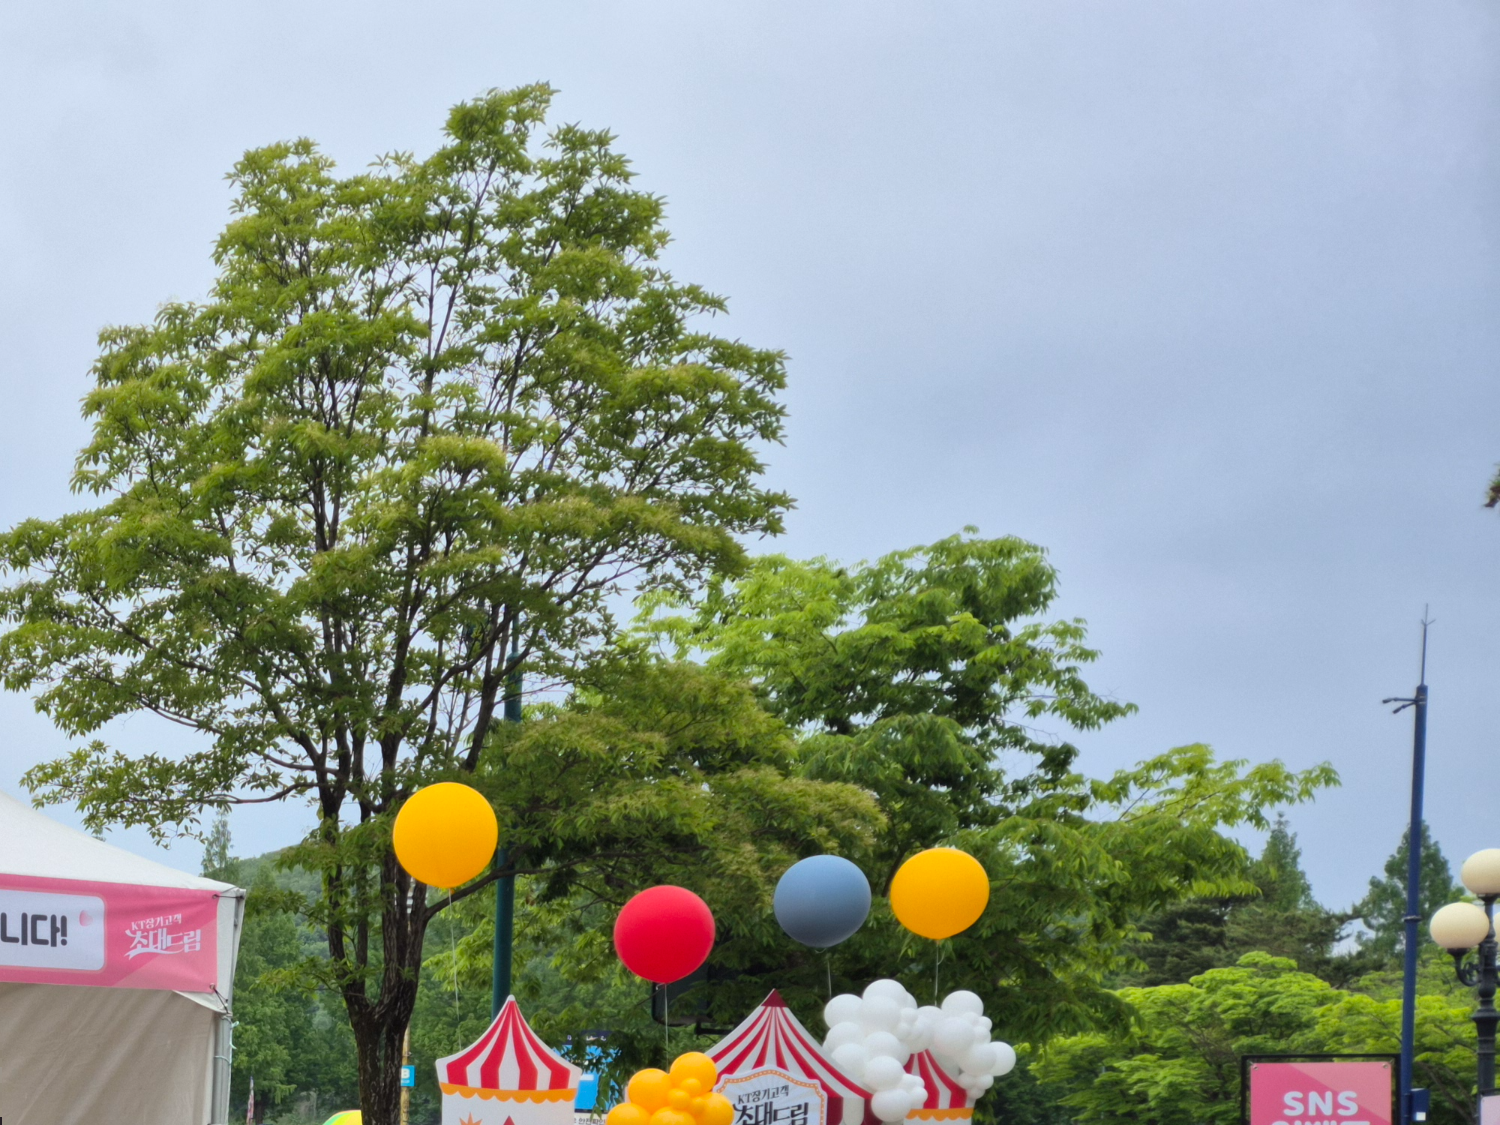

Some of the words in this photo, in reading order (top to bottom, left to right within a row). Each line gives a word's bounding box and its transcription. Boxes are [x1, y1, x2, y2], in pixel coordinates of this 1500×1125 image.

[124, 928, 201, 960] 초대드림
[737, 1084, 790, 1105] KT장기고객
[1283, 1090, 1359, 1116] SNS
